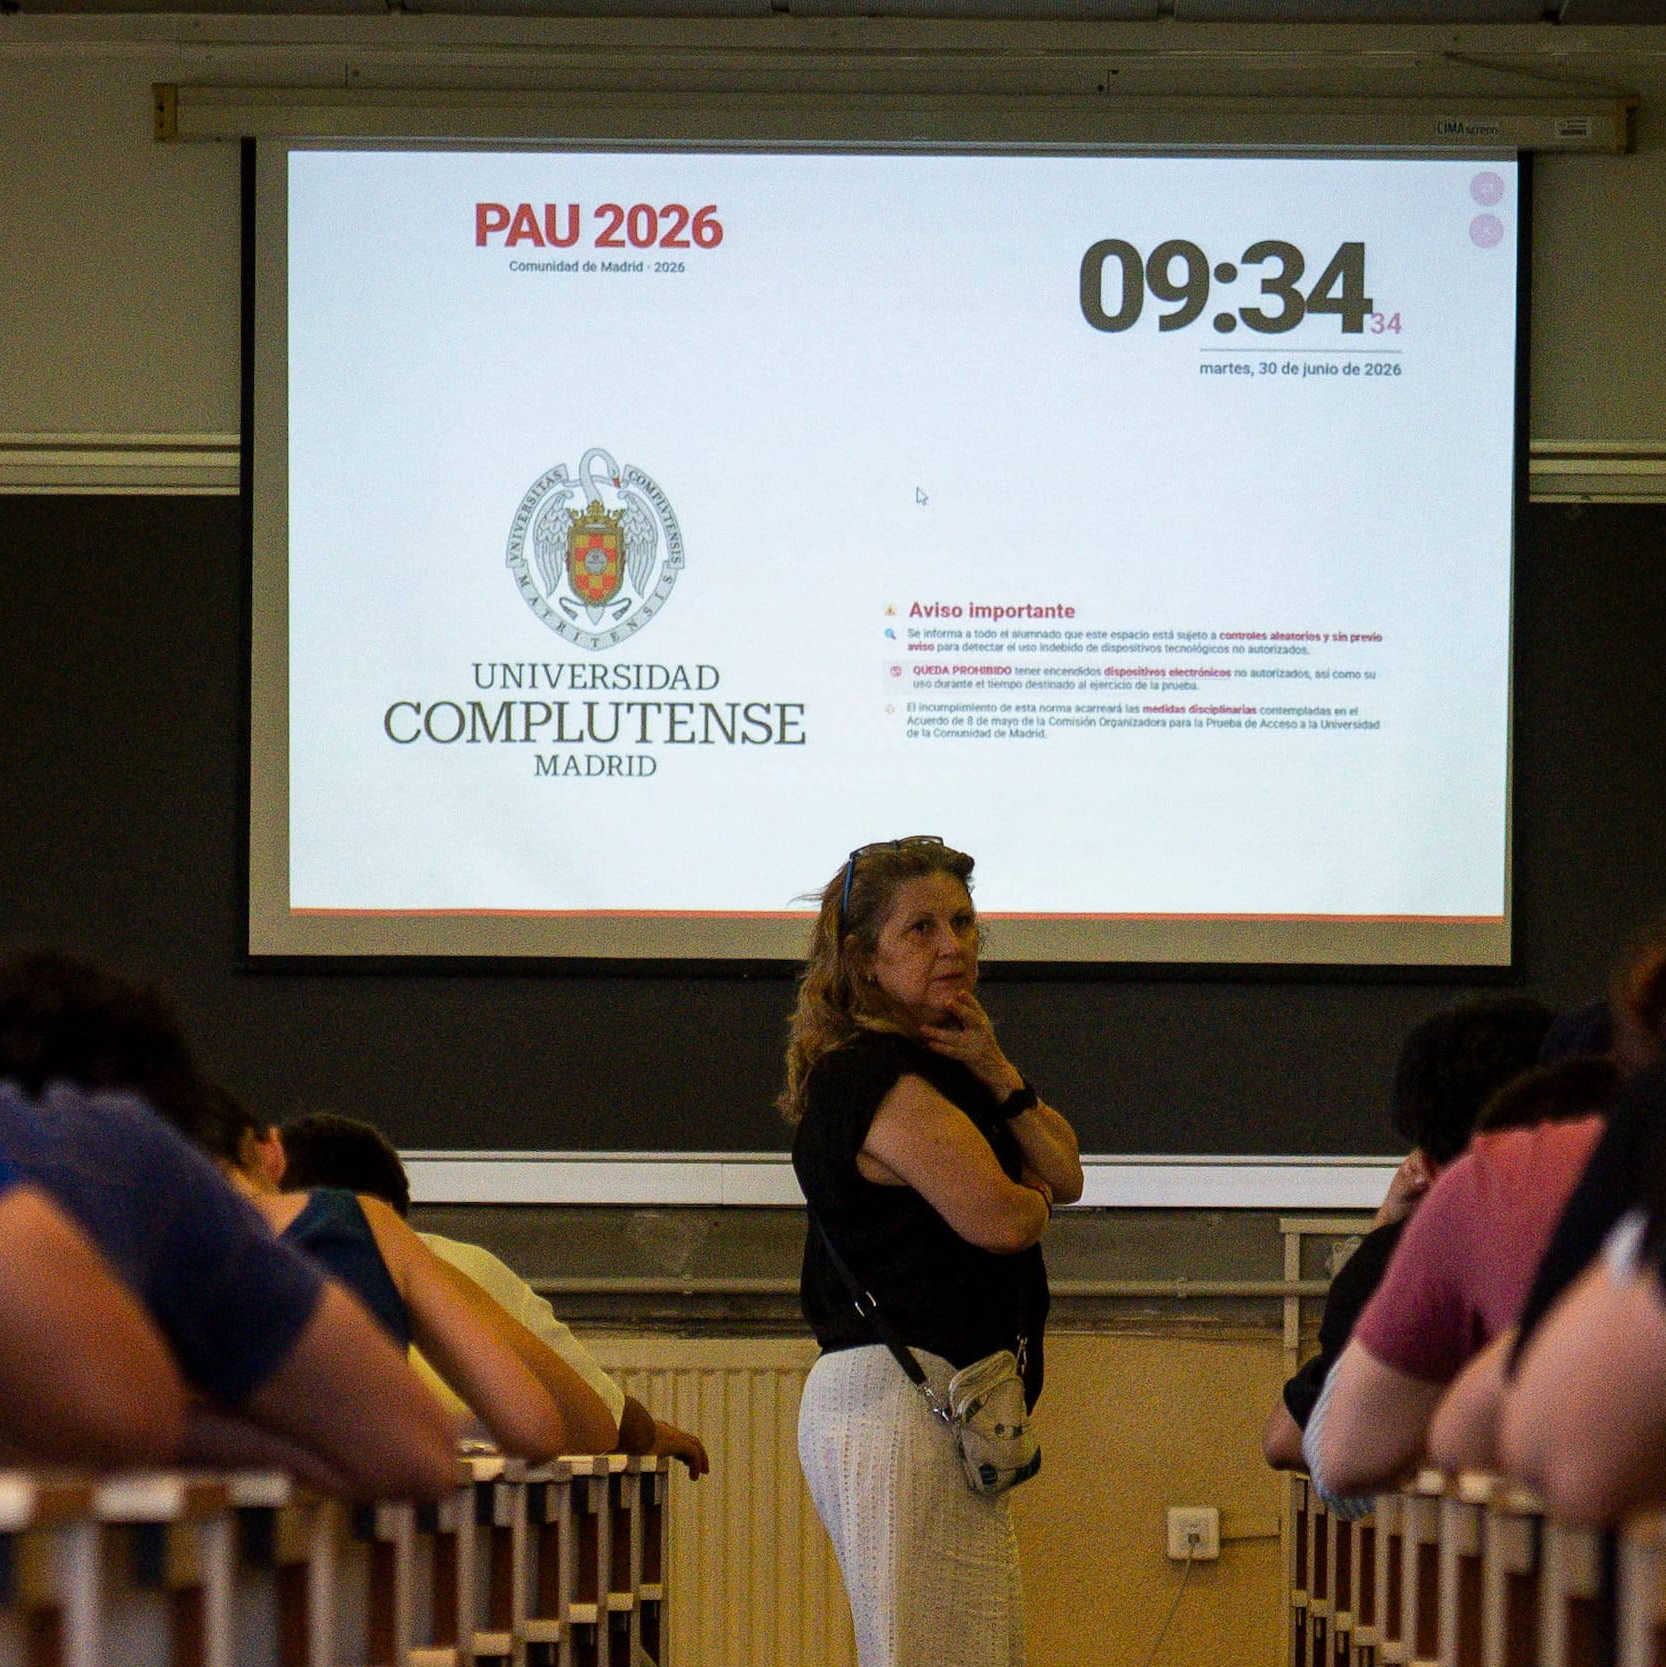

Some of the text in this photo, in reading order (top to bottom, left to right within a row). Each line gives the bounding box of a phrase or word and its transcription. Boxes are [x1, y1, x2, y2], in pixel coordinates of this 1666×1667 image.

[475, 203, 723, 248] PAU 2026
[509, 260, 578, 272] Comunidad
[582, 260, 597, 272] de
[601, 261, 643, 273] Madrid
[654, 261, 685, 273] 2026
[1080, 239, 1402, 334] 09:34 34
[1200, 362, 1402, 378] martes, 30 de junio de 2026
[909, 602, 1076, 622] Aviso importante
[907, 628, 921, 639] Se
[924, 629, 962, 639] informa
[965, 631, 972, 639] a
[974, 628, 997, 639] todo
[1000, 628, 1009, 639] el
[1012, 629, 1061, 639] alumnado
[1065, 631, 1083, 641] que
[1086, 629, 1107, 639] este
[1111, 629, 1149, 641] espacio
[1152, 629, 1174, 640] está
[1177, 630, 1207, 642] sujeto
[1220, 631, 1267, 641] controles
[1270, 631, 1320, 641] aleatorios
[1323, 634, 1329, 643] y
[1333, 631, 1347, 642] sin
[1350, 632, 1382, 644] previo
[908, 641, 1310, 655] aviso para detectar el uso indebido de dispositivos tecnológicos no autorizados.
[472, 663, 720, 690] UNIVERSIDAD
[913, 665, 949, 677] QUEDA
[952, 665, 1012, 675] PROHIBIDO
[1015, 665, 1040, 675] tener
[1044, 665, 1101, 676] encendidos
[1104, 666, 1166, 678] dispositivos
[1169, 667, 1231, 677] electrónicos
[1234, 670, 1247, 678] no
[1250, 668, 1312, 680] autorizados,
[1315, 669, 1330, 679] así
[1333, 671, 1361, 679] como
[913, 678, 1198, 691] uso durante el tiempo destinado al ejercicio de la prueba.
[907, 702, 1358, 717] El incumplimiento de esta norma acarreará las medidas disciplinarias contempladas en el
[384, 701, 806, 745] COMPLUTENSE
[907, 716, 1380, 729] Acuerdo de 8 de mayo de la Comisión Organizadora para la Prueba de Acceso a la Universidad
[907, 728, 1047, 738] de la Comunidad de Madrid.
[534, 755, 657, 777] MADRID
